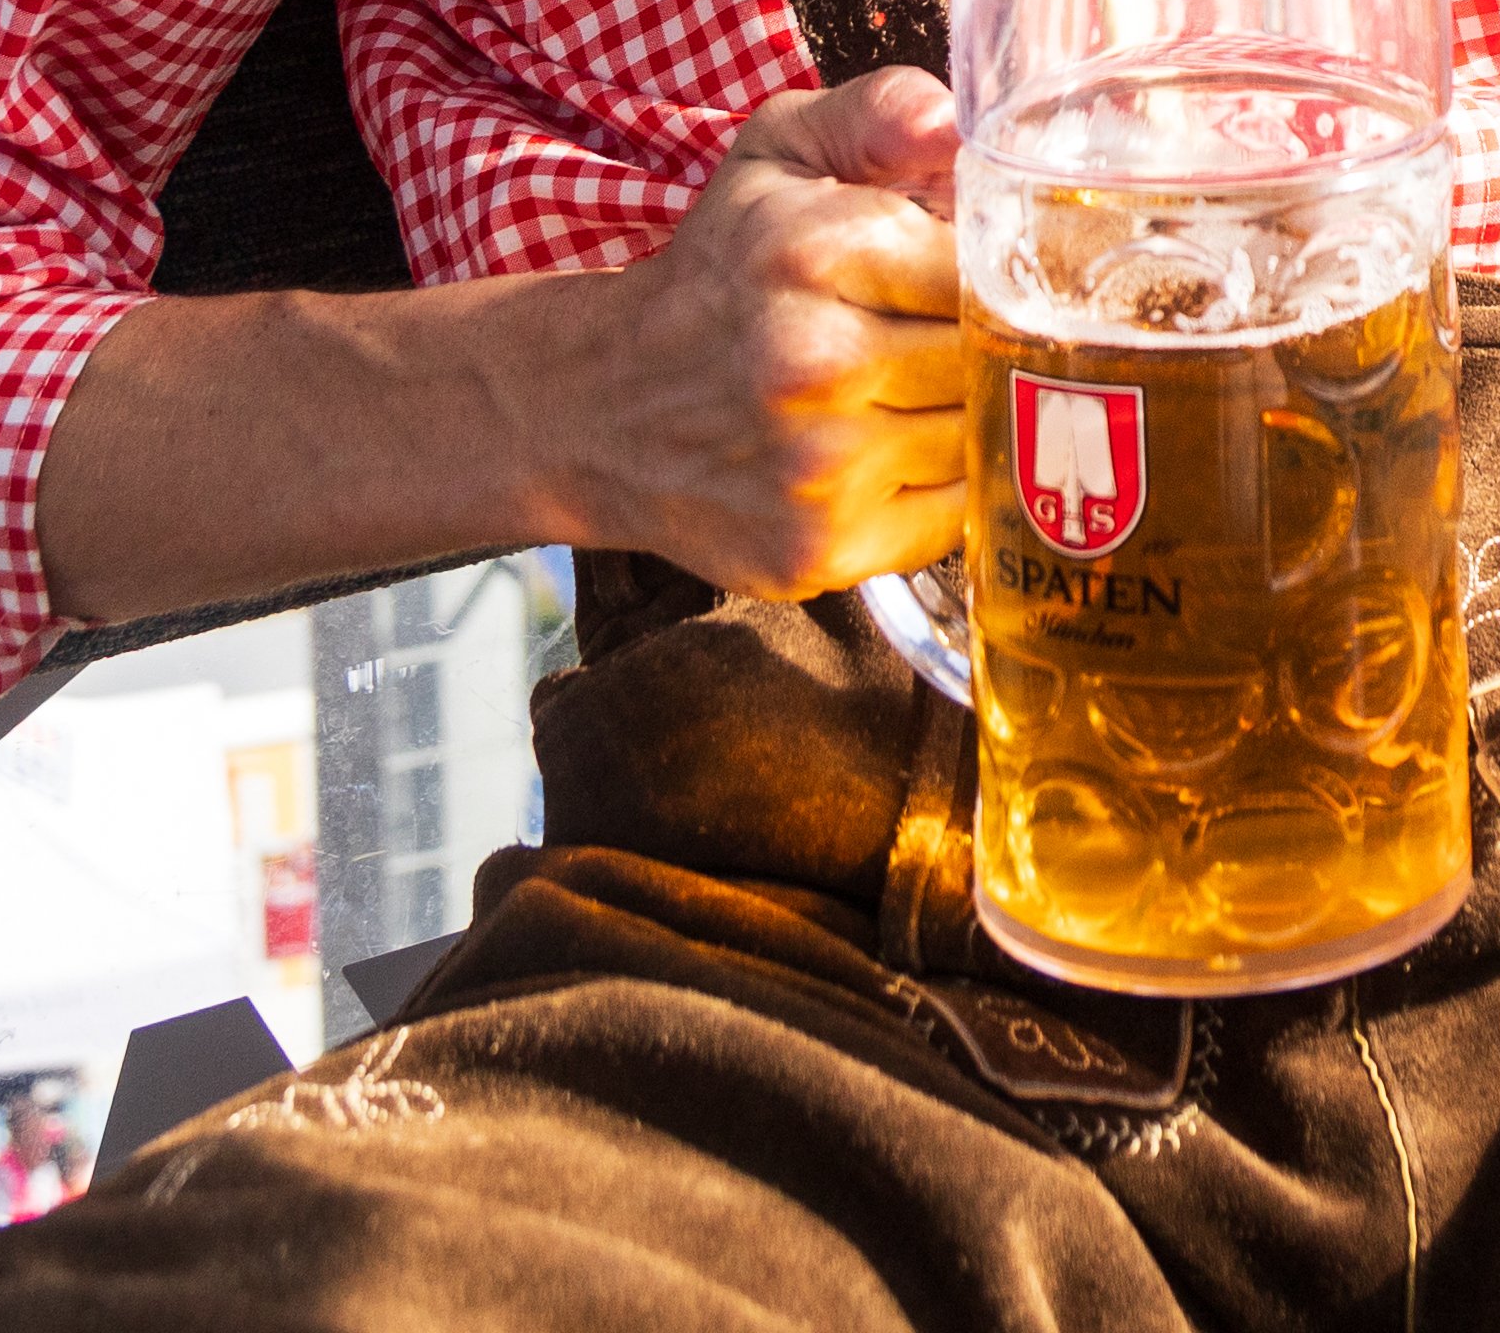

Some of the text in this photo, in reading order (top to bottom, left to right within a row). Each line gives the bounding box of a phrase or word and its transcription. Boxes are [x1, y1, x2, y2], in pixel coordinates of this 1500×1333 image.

[1033, 493, 1057, 524] G
[1089, 503, 1116, 534] S
[996, 546, 1182, 618] SPATEN
